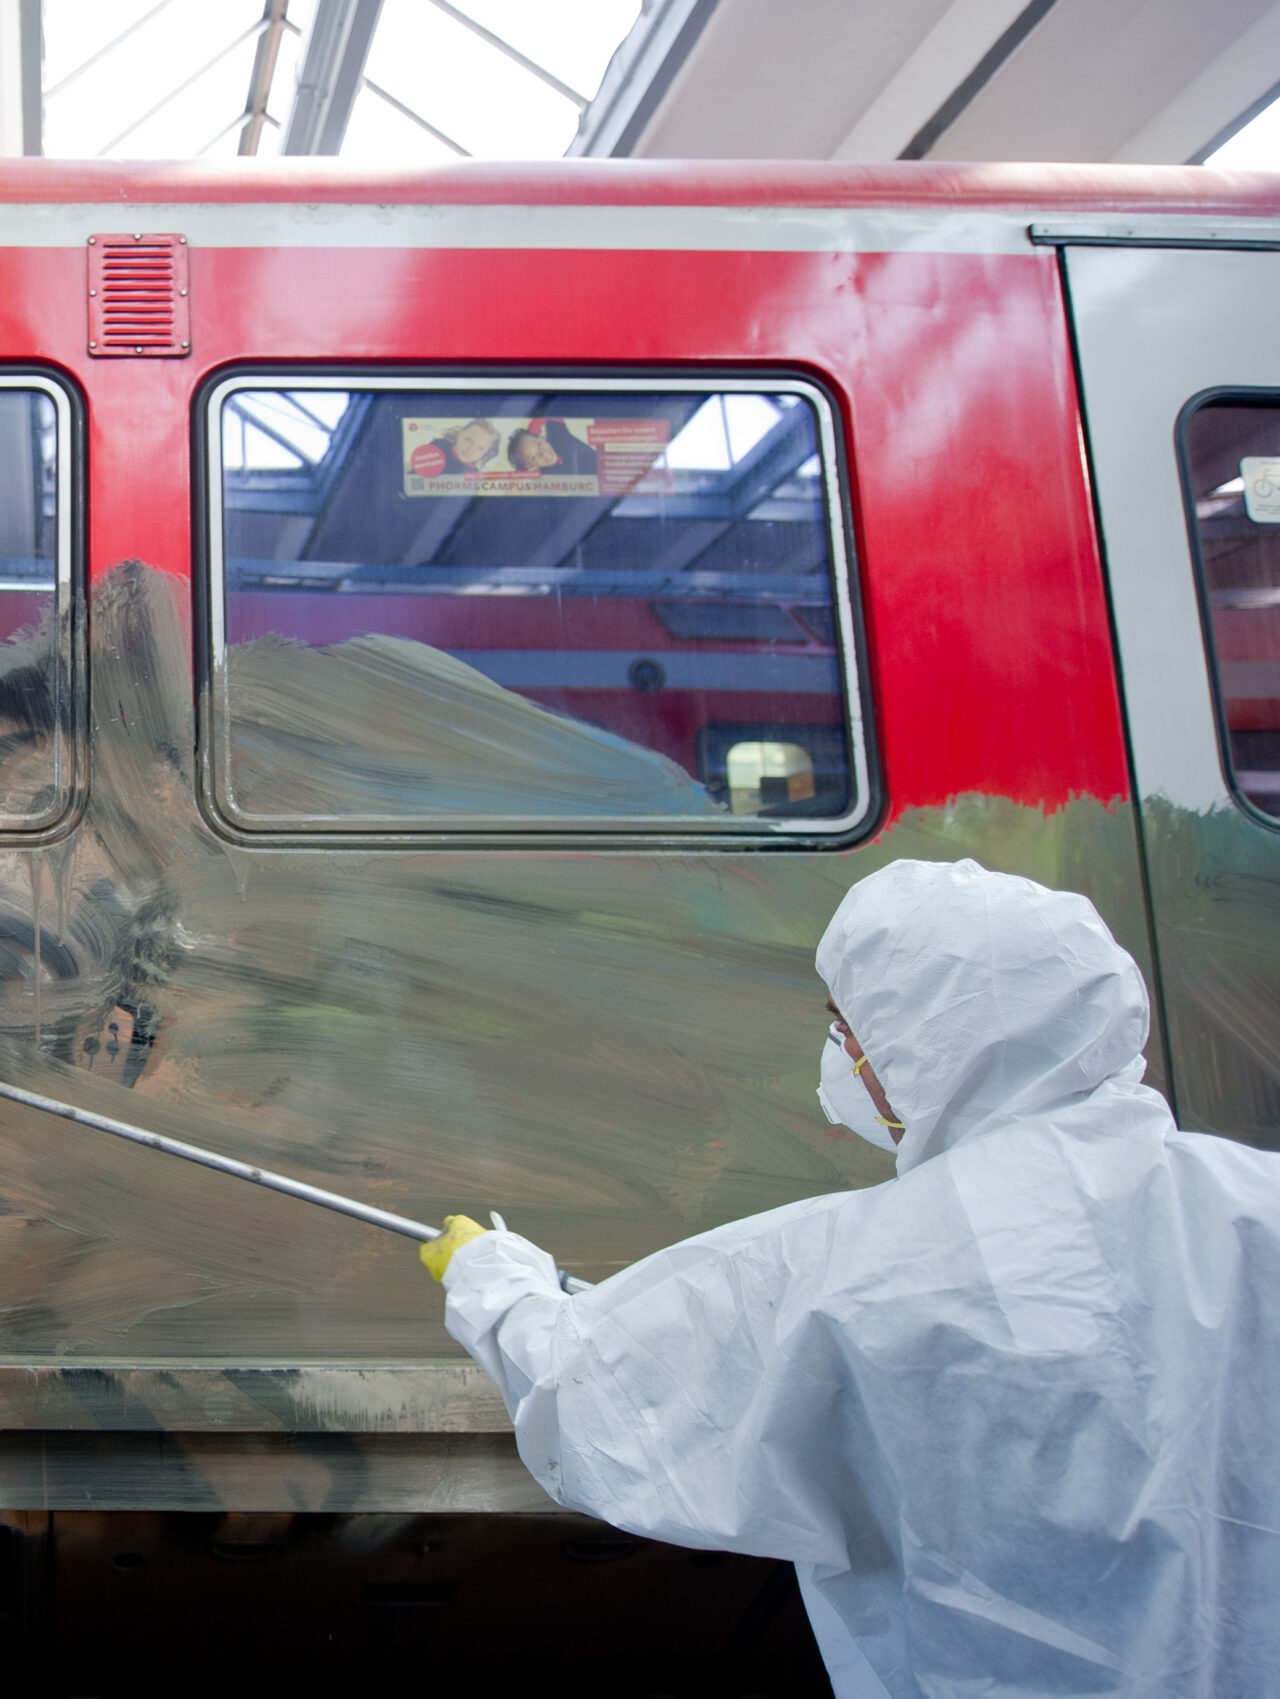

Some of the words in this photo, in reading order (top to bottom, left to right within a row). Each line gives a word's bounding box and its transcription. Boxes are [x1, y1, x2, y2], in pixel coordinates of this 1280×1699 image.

[429, 480, 479, 491] PHORMS
[481, 480, 531, 491] CAMPUS
[533, 480, 594, 491] HAMBURG
